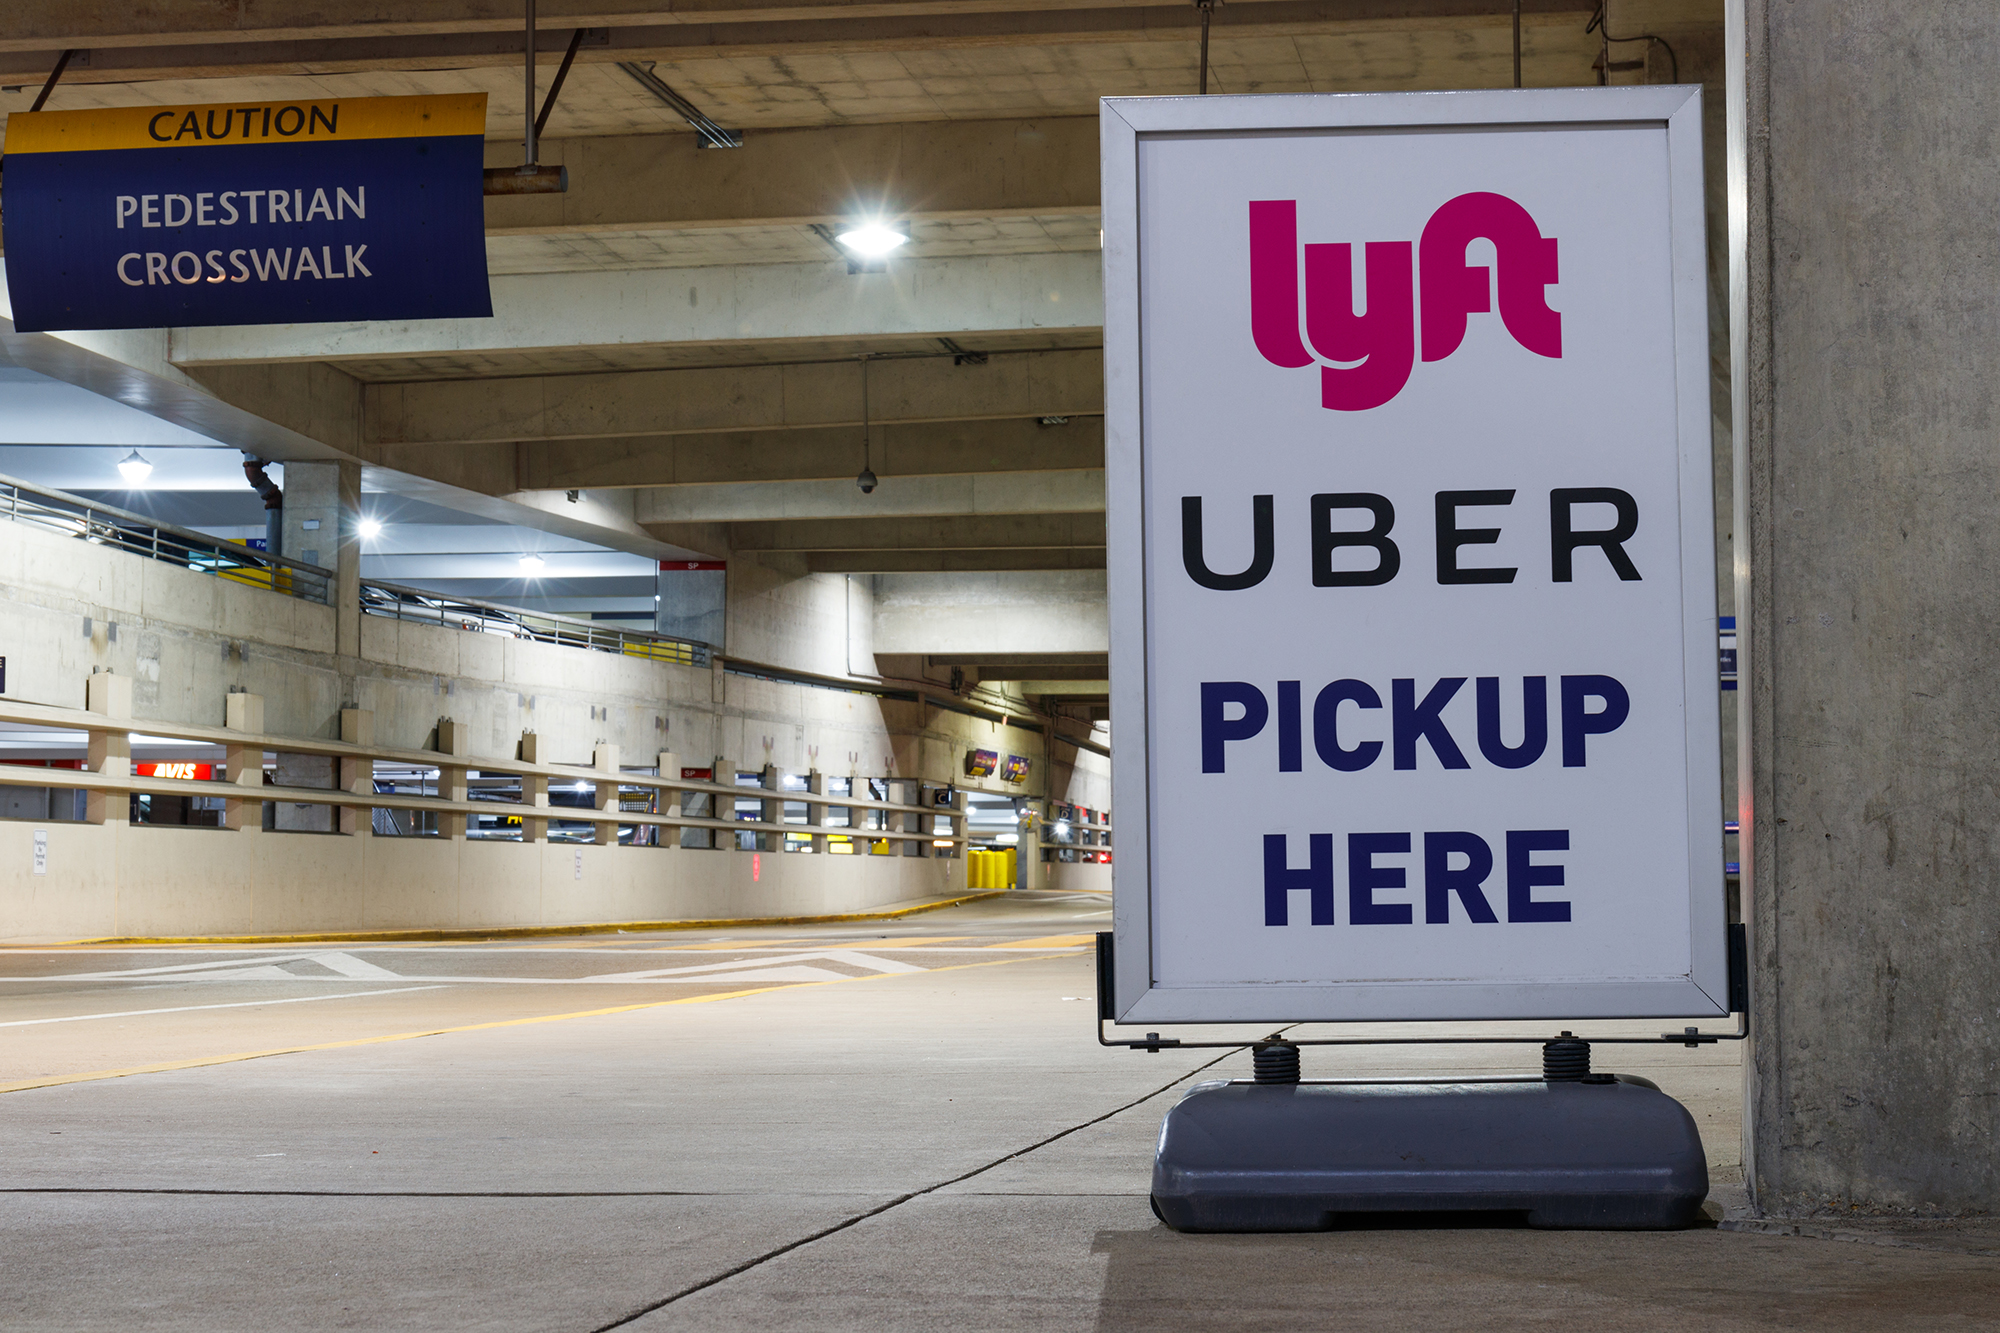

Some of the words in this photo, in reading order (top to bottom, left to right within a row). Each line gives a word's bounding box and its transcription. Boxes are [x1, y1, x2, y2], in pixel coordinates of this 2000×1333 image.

[148, 104, 338, 142] CAUTION
[115, 185, 366, 229] PEDESTRIAN
[116, 244, 372, 287] CROSSWALK
[1249, 192, 1562, 411] lyft
[1181, 487, 1643, 591] UBER
[1201, 675, 1630, 773] PICKUP
[153, 762, 197, 780] AVIS
[938, 793, 946, 803] C
[1263, 830, 1572, 926] HERE
